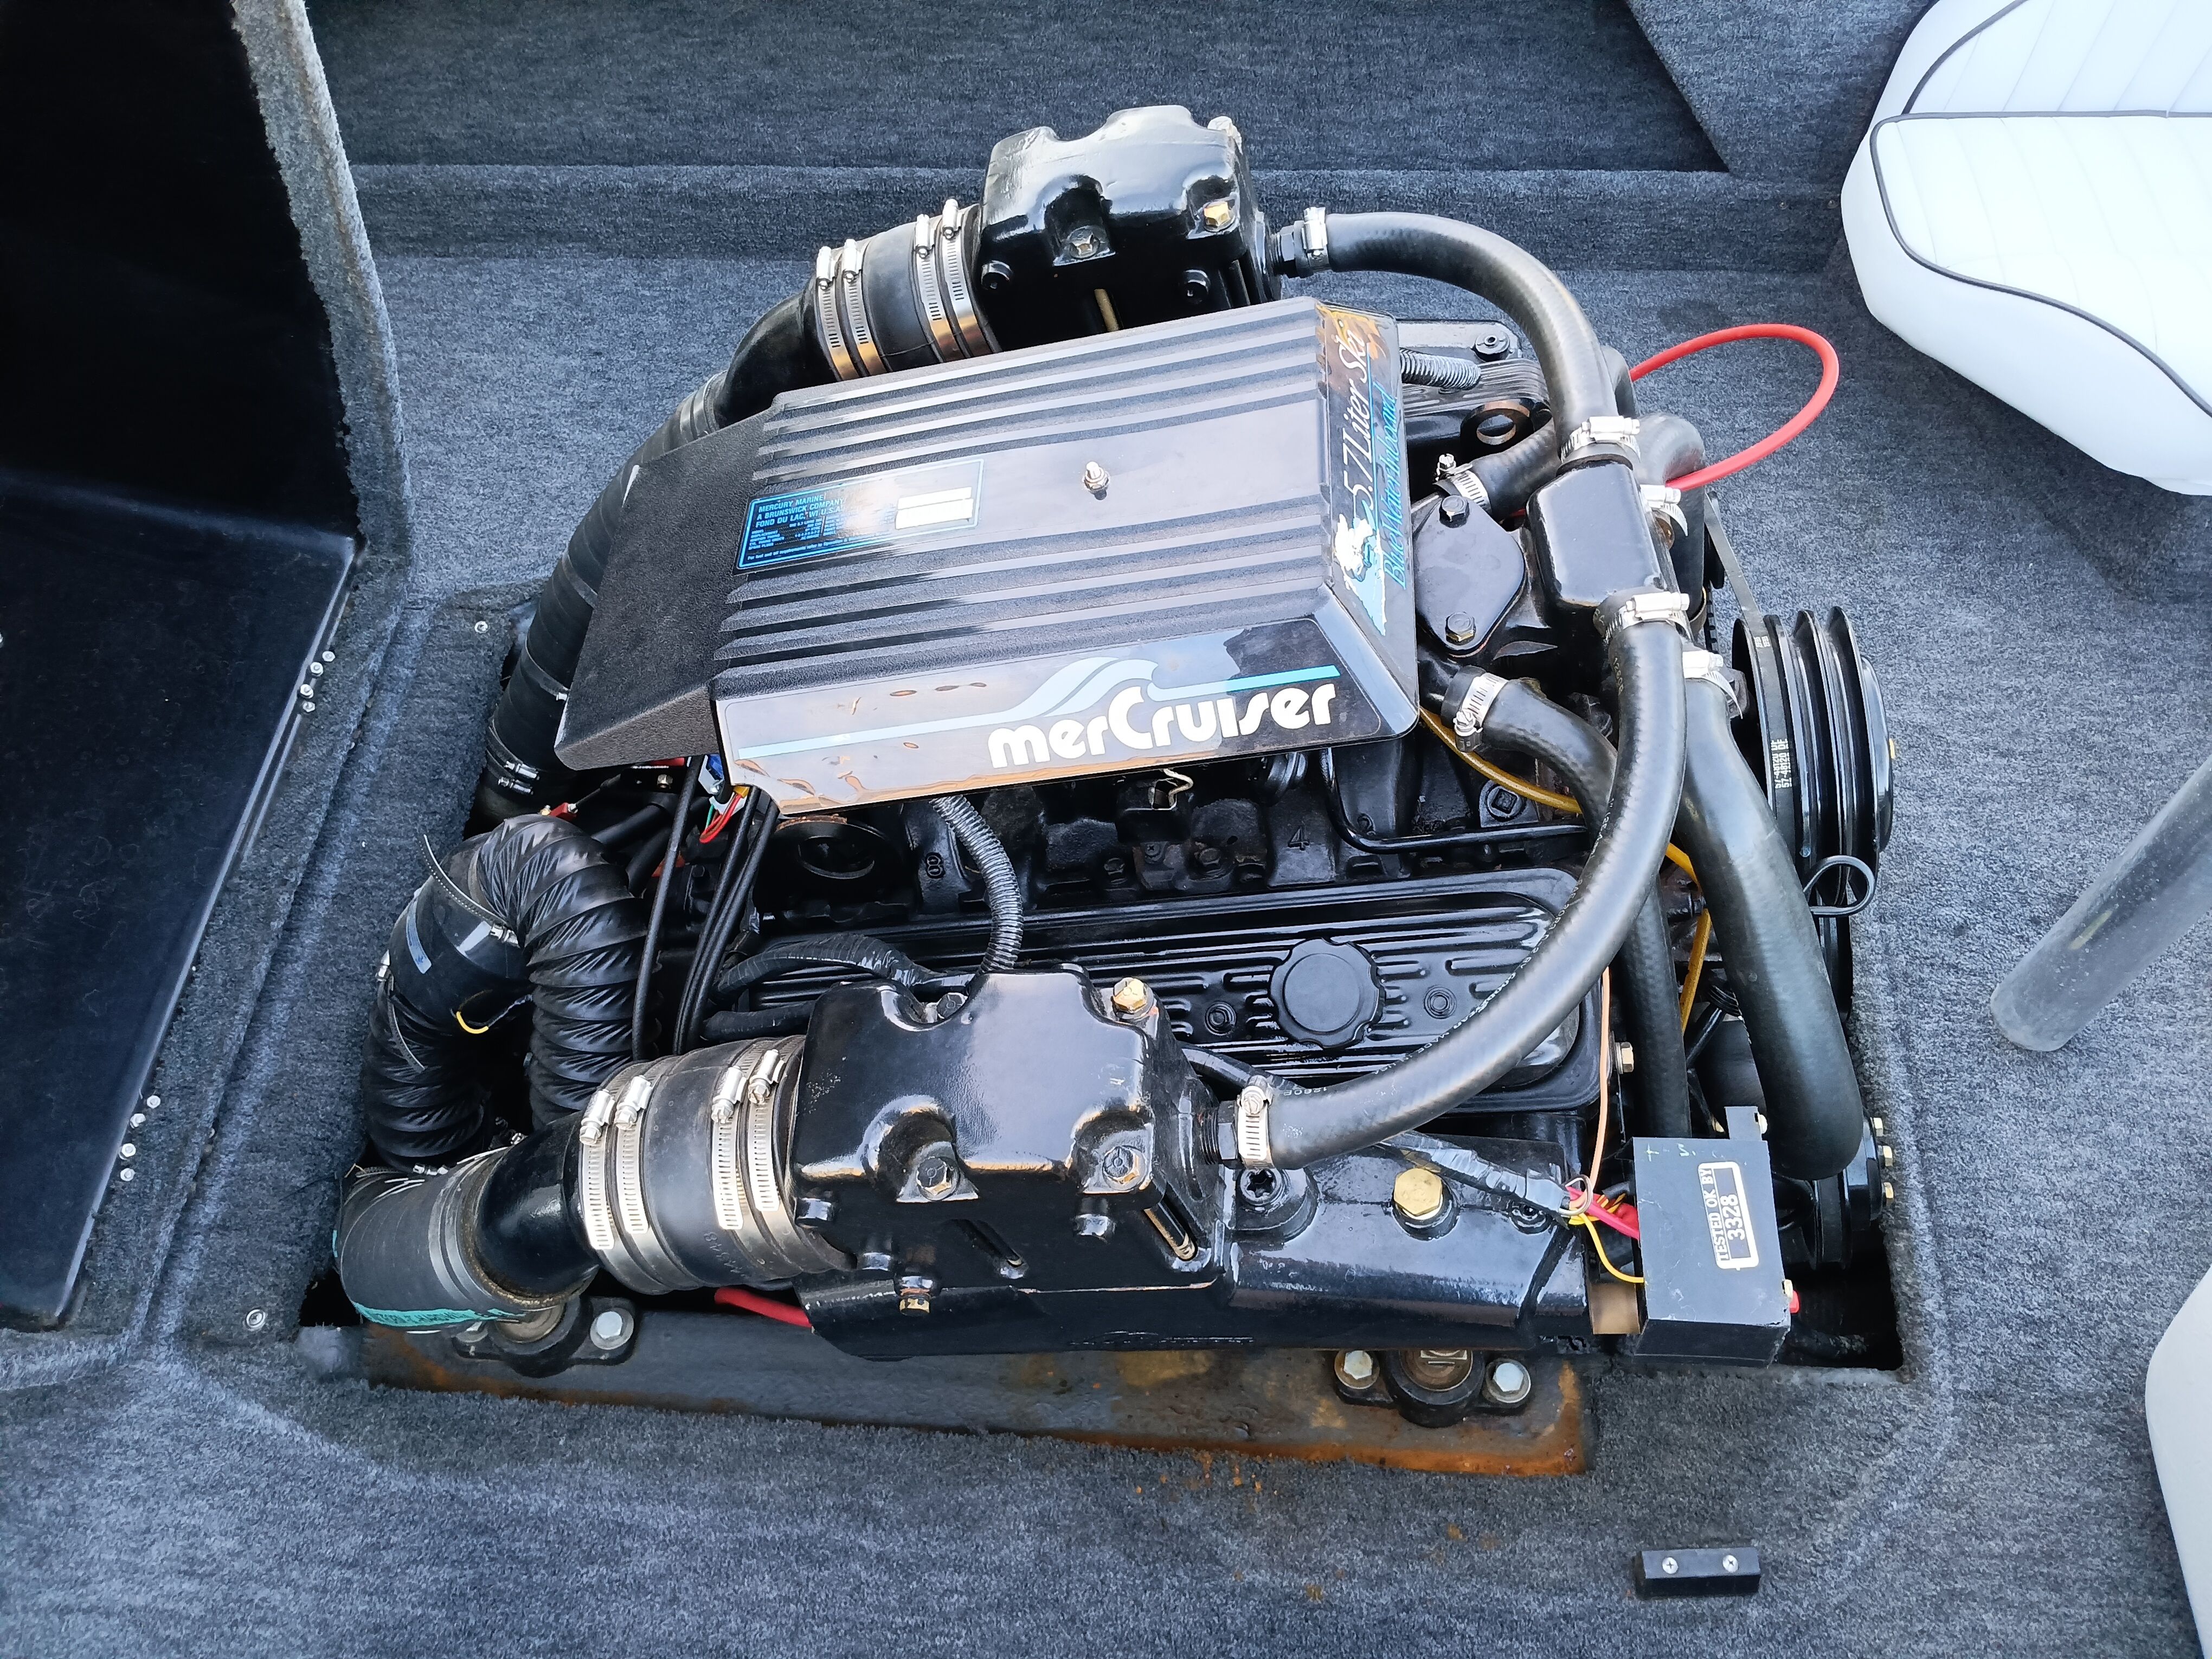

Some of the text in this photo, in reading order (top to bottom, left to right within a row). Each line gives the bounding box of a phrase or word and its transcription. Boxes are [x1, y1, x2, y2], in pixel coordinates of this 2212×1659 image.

[1343, 378, 1372, 464] Liter
[1343, 443, 1374, 511] 5.7
[755, 519, 775, 528] FOND
[758, 494, 824, 513] MERCURY MARINE
[764, 505, 807, 519] BRUNSWICK
[809, 498, 844, 510] COMPANY
[1700, 1168, 1730, 1261] TESTED OK BY
[1720, 1194, 1746, 1240] 3328
